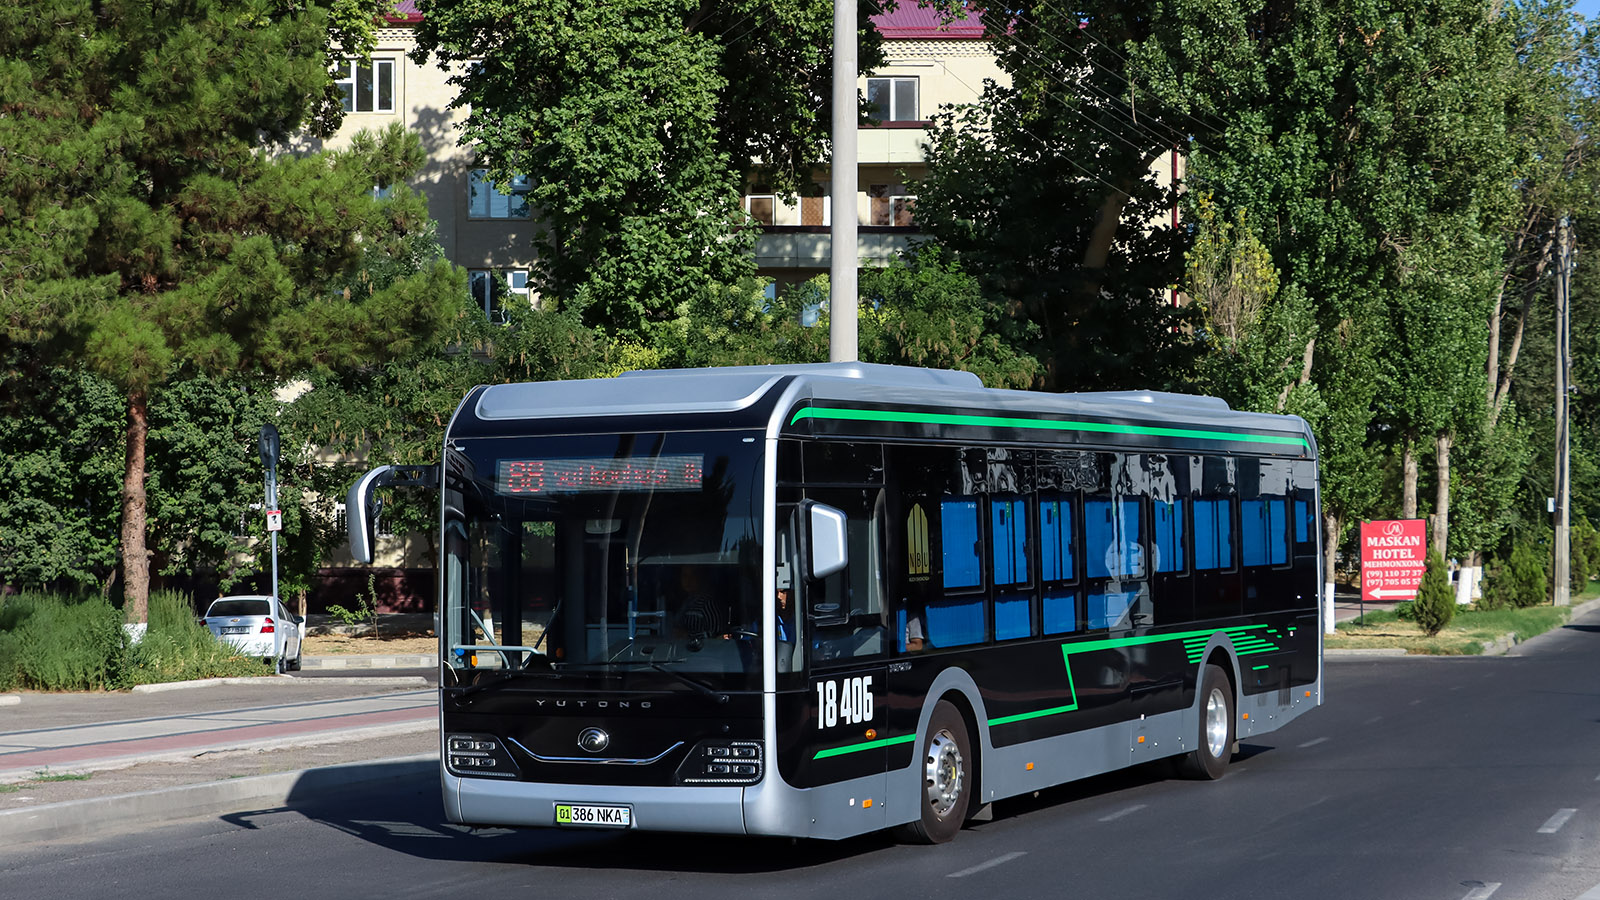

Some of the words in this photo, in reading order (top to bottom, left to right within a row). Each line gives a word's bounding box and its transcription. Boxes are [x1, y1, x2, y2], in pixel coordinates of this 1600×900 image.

[1367, 536, 1420, 547] MASKAN
[1373, 549, 1415, 559] HOTEL
[1364, 560, 1424, 568] MEHMONXONA
[1366, 579, 1383, 587] (97)
[536, 700, 652, 708] YUTONG
[817, 681, 837, 729] 18
[840, 676, 873, 725] 406
[560, 809, 570, 819] 01
[573, 808, 594, 822] 386
[597, 808, 622, 823] NKA
